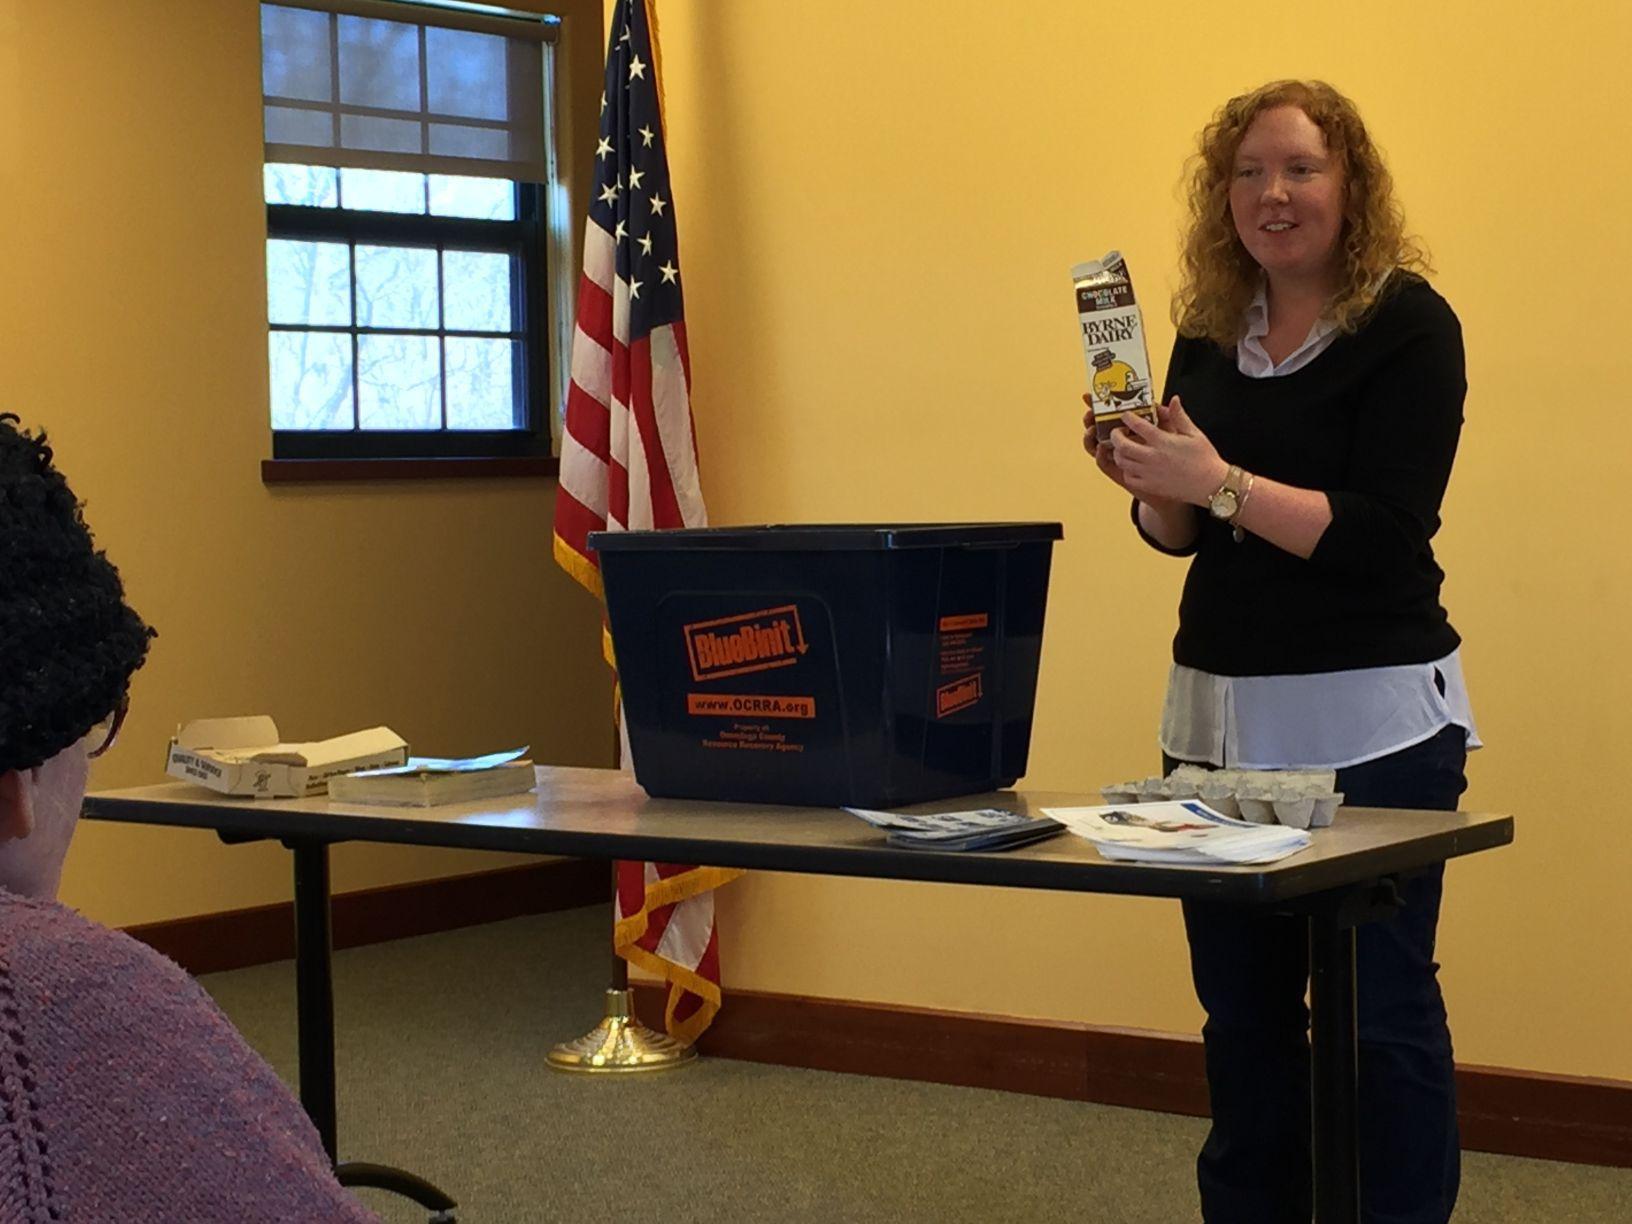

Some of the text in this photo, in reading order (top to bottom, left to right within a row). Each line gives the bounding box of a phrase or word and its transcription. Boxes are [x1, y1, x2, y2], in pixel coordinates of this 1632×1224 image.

[1082, 314, 1138, 335] BYRNE
[1087, 327, 1133, 346] DAIRY
[694, 698, 809, 716] www.OCRRA.org
